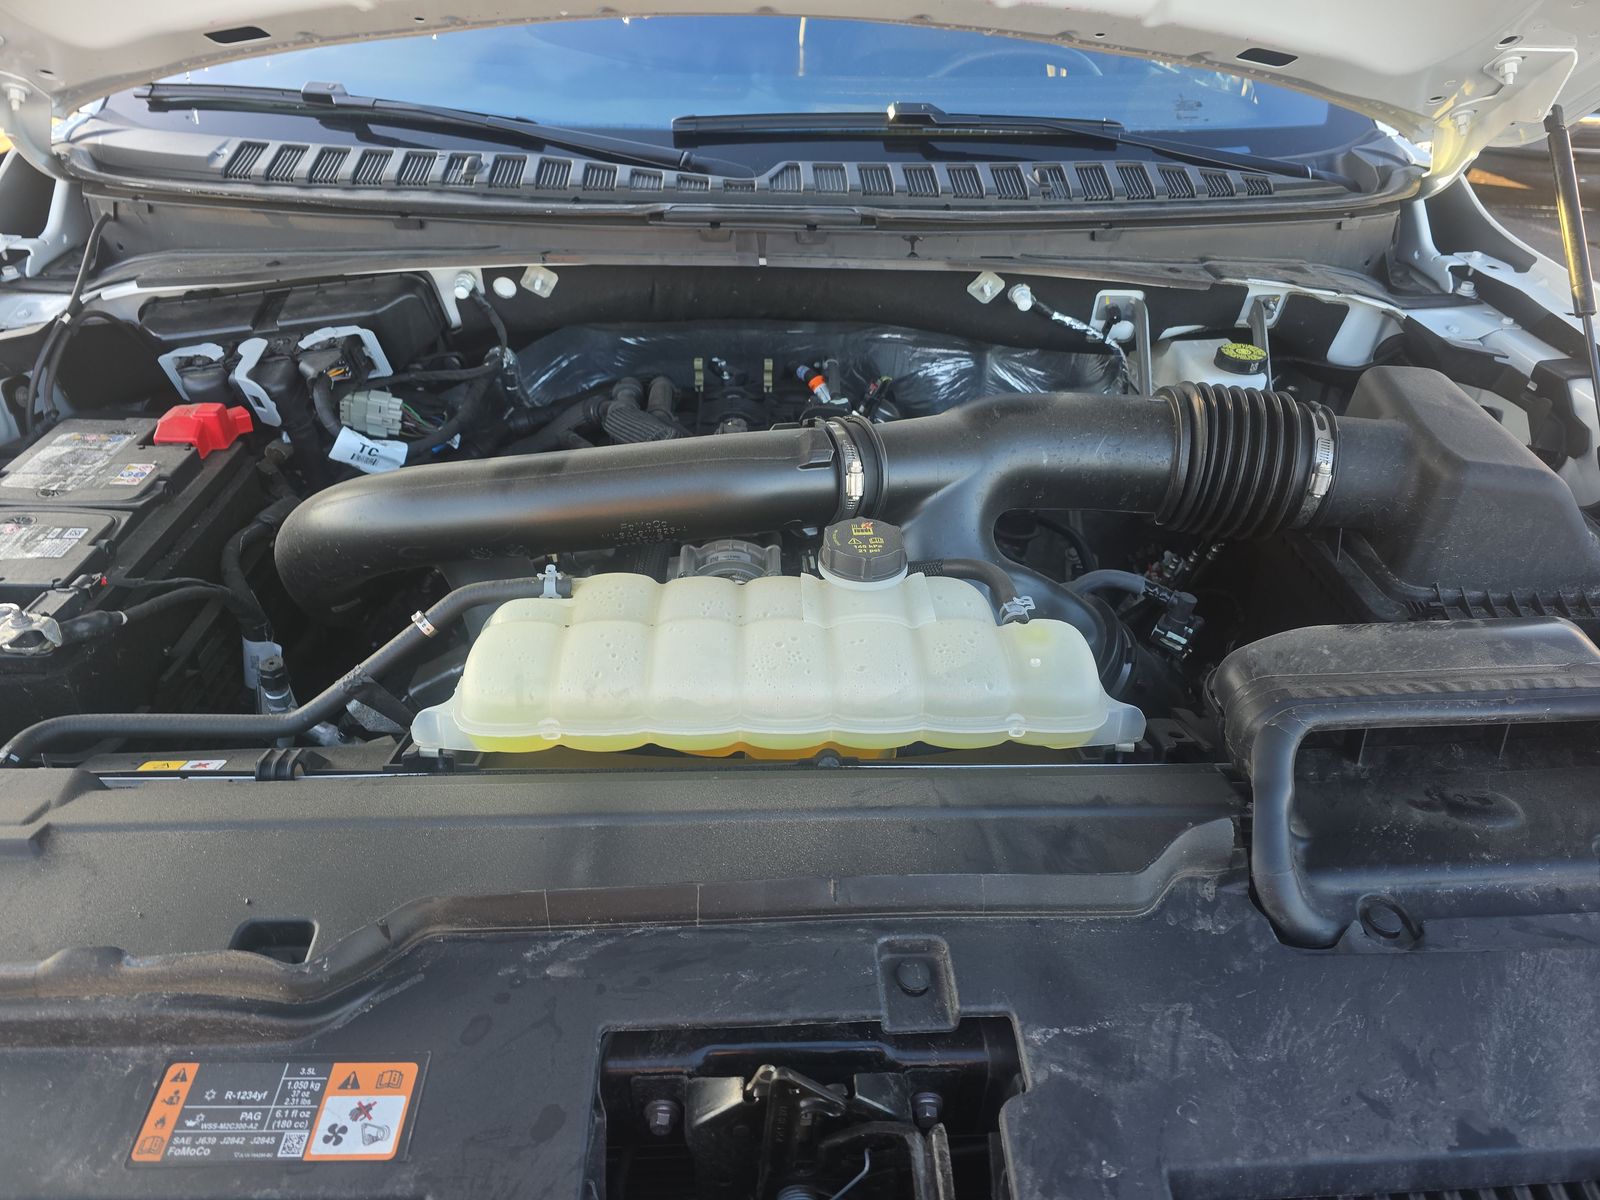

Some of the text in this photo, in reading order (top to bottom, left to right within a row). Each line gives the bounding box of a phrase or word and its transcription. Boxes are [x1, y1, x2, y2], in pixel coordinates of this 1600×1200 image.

[359, 442, 380, 457] TC
[299, 1067, 317, 1076] 3.5L
[287, 1080, 321, 1092] 1.050 kg
[224, 1090, 268, 1101] R-1234yf
[239, 1112, 262, 1121] PAG
[275, 1109, 290, 1118] 6.1
[299, 1110, 311, 1118] oz
[272, 1120, 309, 1130] (180 cc)
[172, 1136, 192, 1145] SAE
[167, 1146, 211, 1157] FoMoCo
